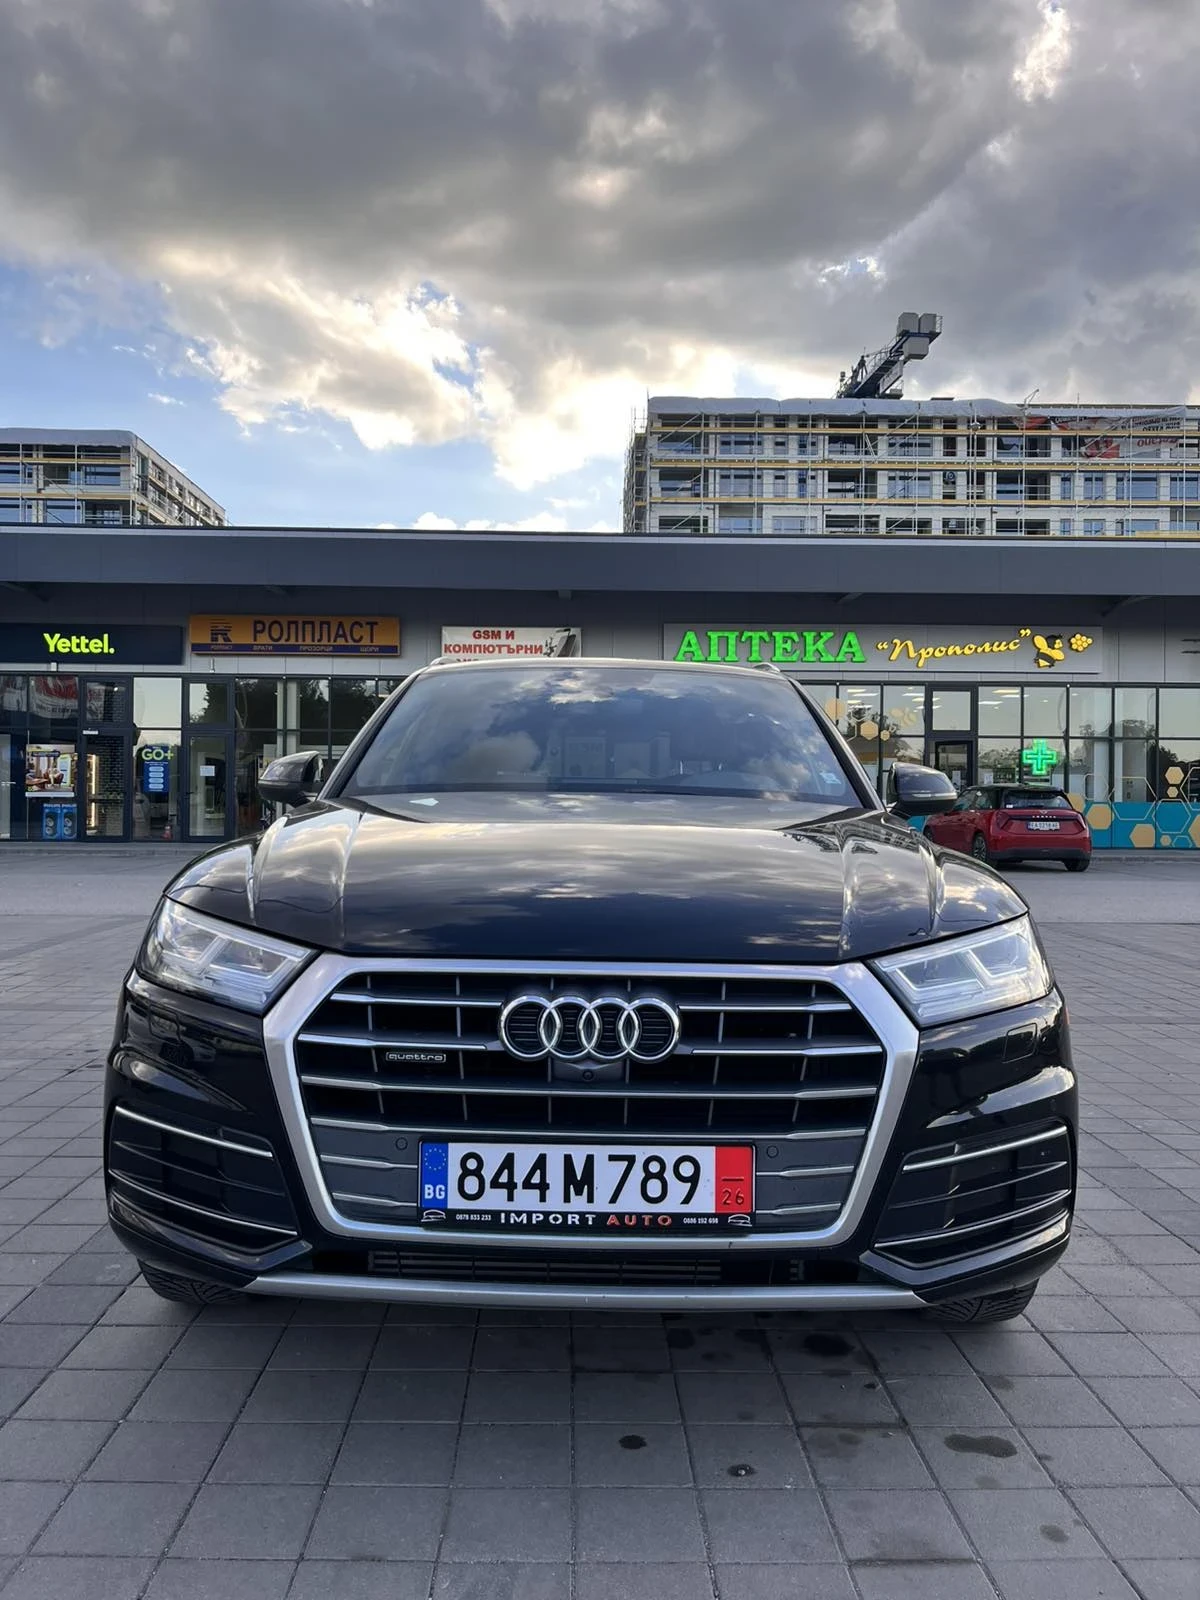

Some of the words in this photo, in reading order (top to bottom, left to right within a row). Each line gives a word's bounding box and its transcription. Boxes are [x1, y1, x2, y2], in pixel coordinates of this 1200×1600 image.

[253, 619, 379, 644] РОЛПЛАСТ
[472, 630, 502, 641] GSM
[505, 630, 515, 640] И
[43, 633, 115, 655] Yettel.
[444, 643, 544, 655] КОМПЮТЪРНИ
[674, 629, 867, 664] АПТЕКА
[388, 1053, 444, 1061] quattro
[457, 1151, 550, 1203] 844
[563, 1153, 595, 1204] M
[607, 1154, 702, 1205] 789
[424, 1184, 446, 1200] BG
[722, 1187, 745, 1206] 26
[500, 1212, 597, 1226] IMPORT
[606, 1214, 673, 1227] AUTO
